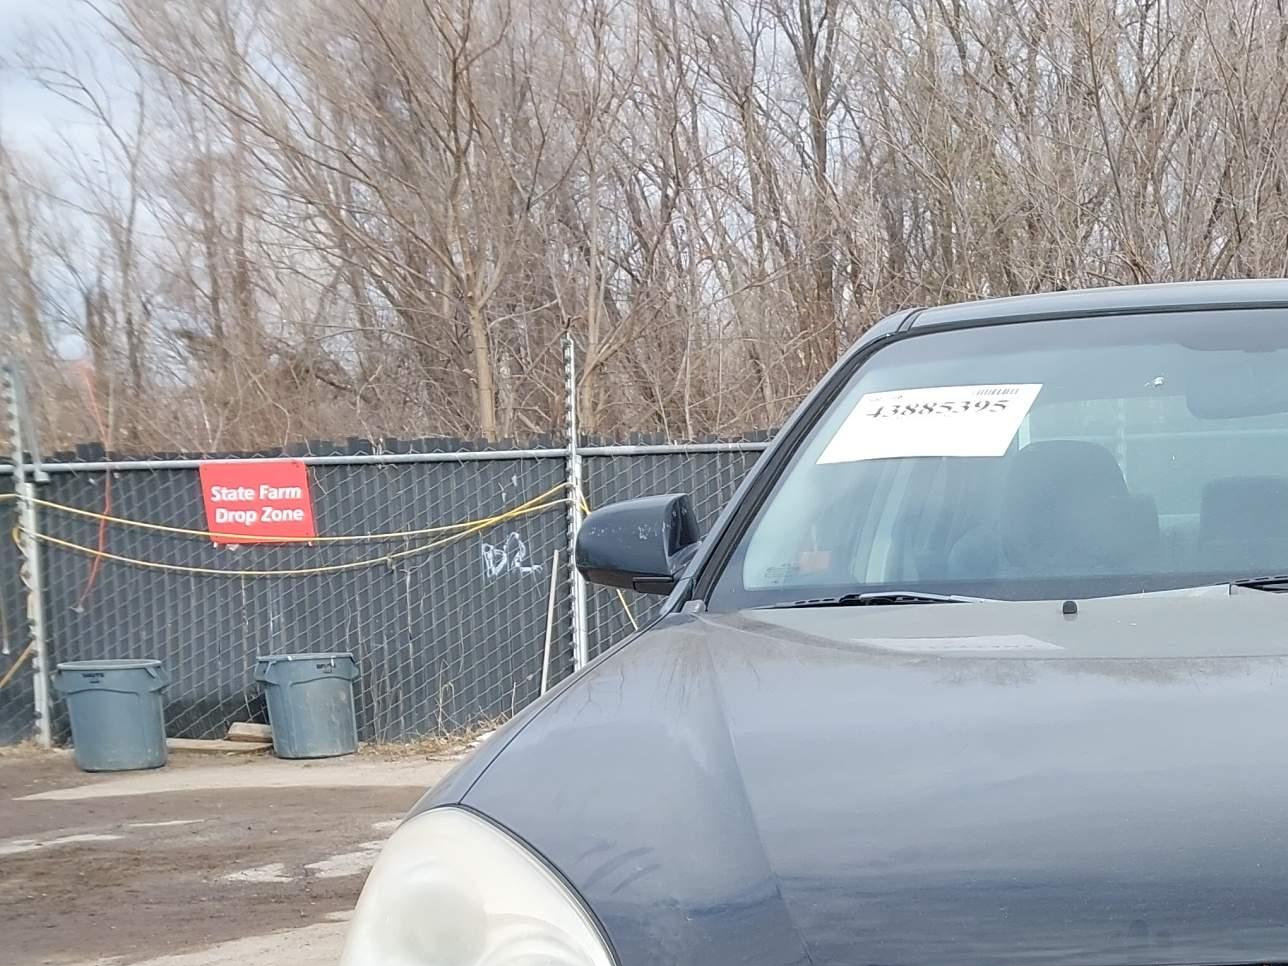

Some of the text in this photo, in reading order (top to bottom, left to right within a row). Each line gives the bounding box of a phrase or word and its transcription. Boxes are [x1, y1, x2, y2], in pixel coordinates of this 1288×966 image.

[866, 400, 1010, 418] 43885395
[211, 484, 302, 502] State Farm
[215, 506, 305, 526] Drop Zone
